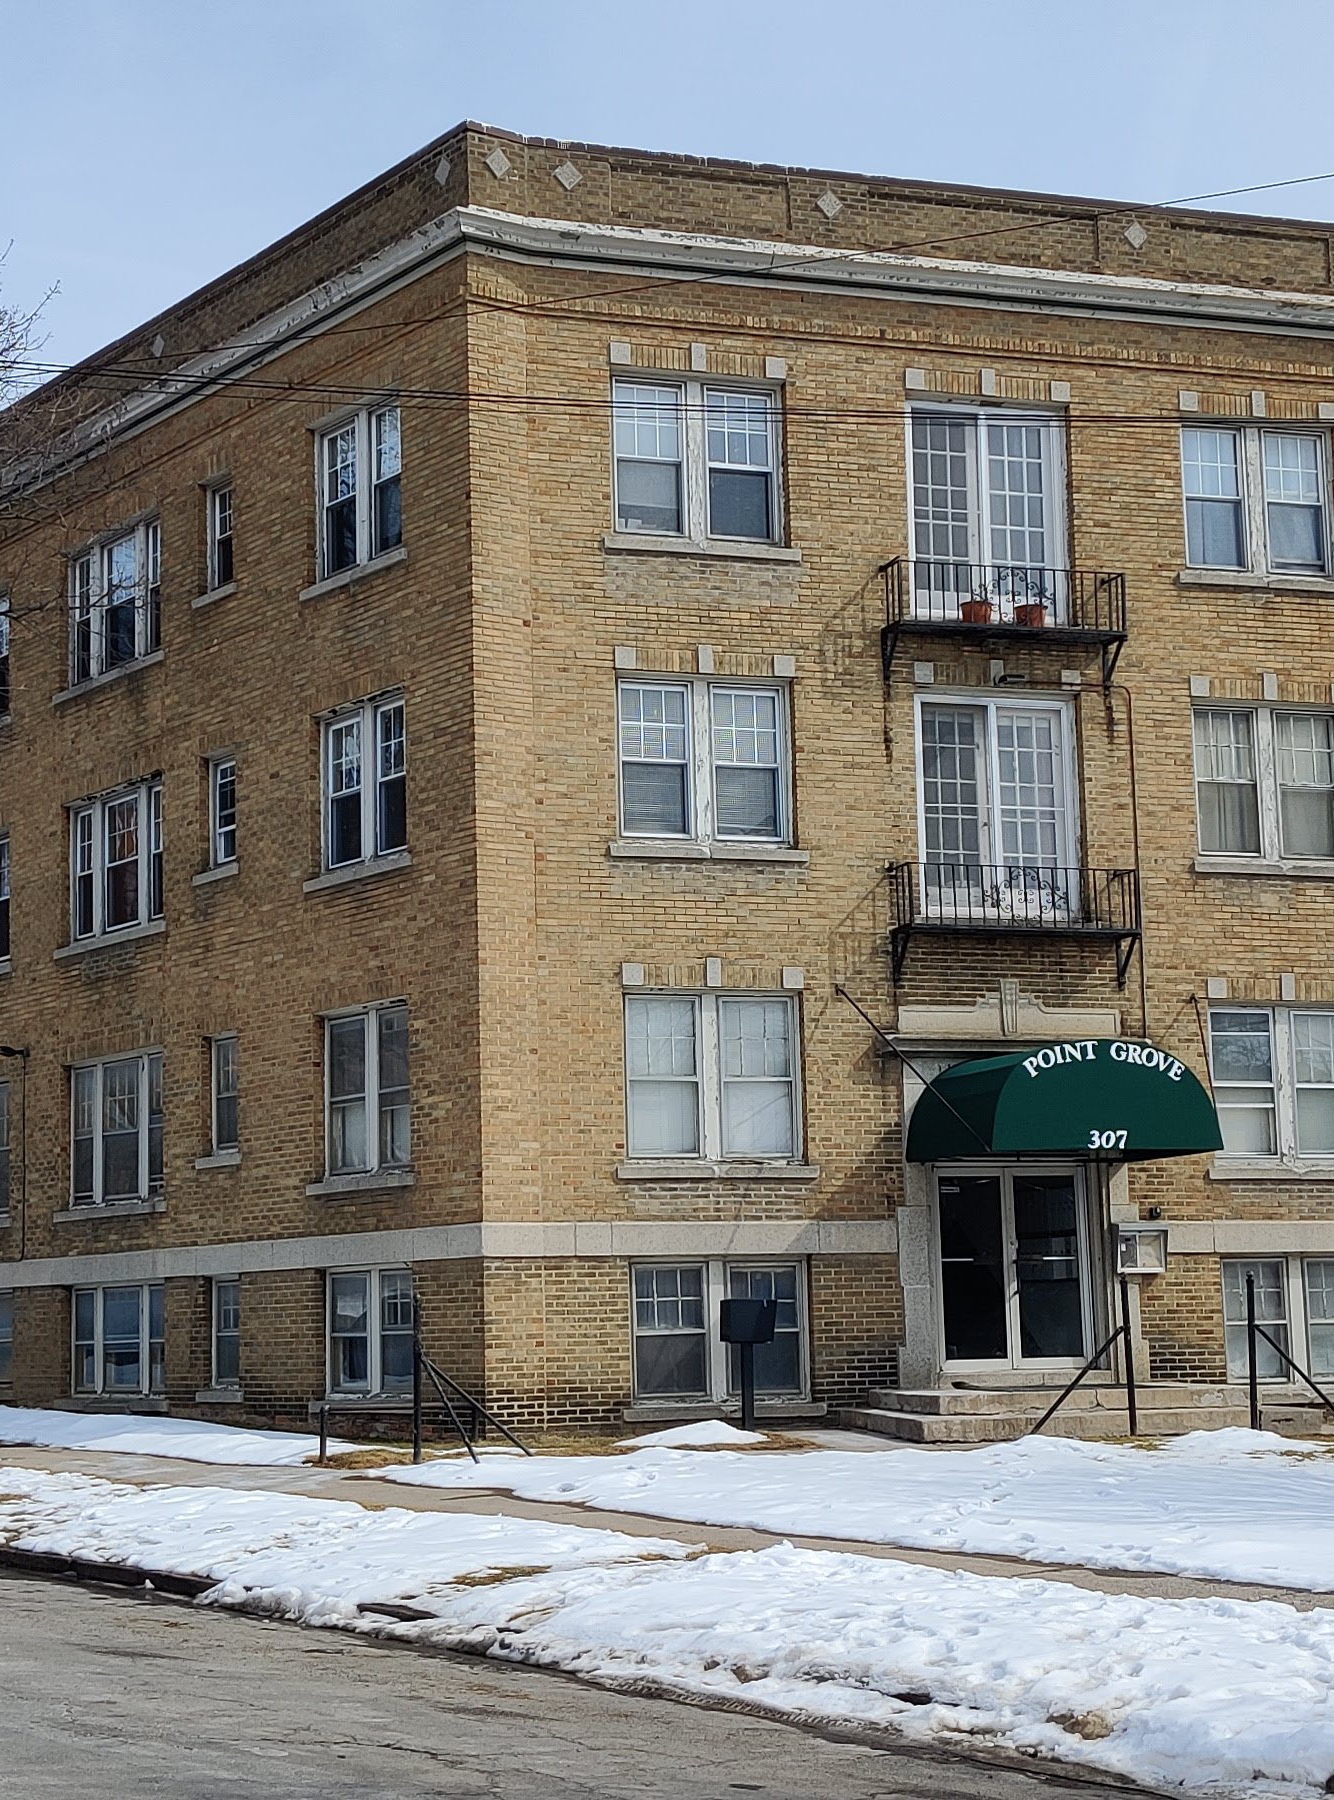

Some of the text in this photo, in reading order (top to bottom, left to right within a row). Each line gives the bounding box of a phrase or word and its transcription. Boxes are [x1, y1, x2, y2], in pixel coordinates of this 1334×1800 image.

[1022, 1041, 1185, 1081] POINT GROVE
[1087, 1130, 1128, 1149] 307
